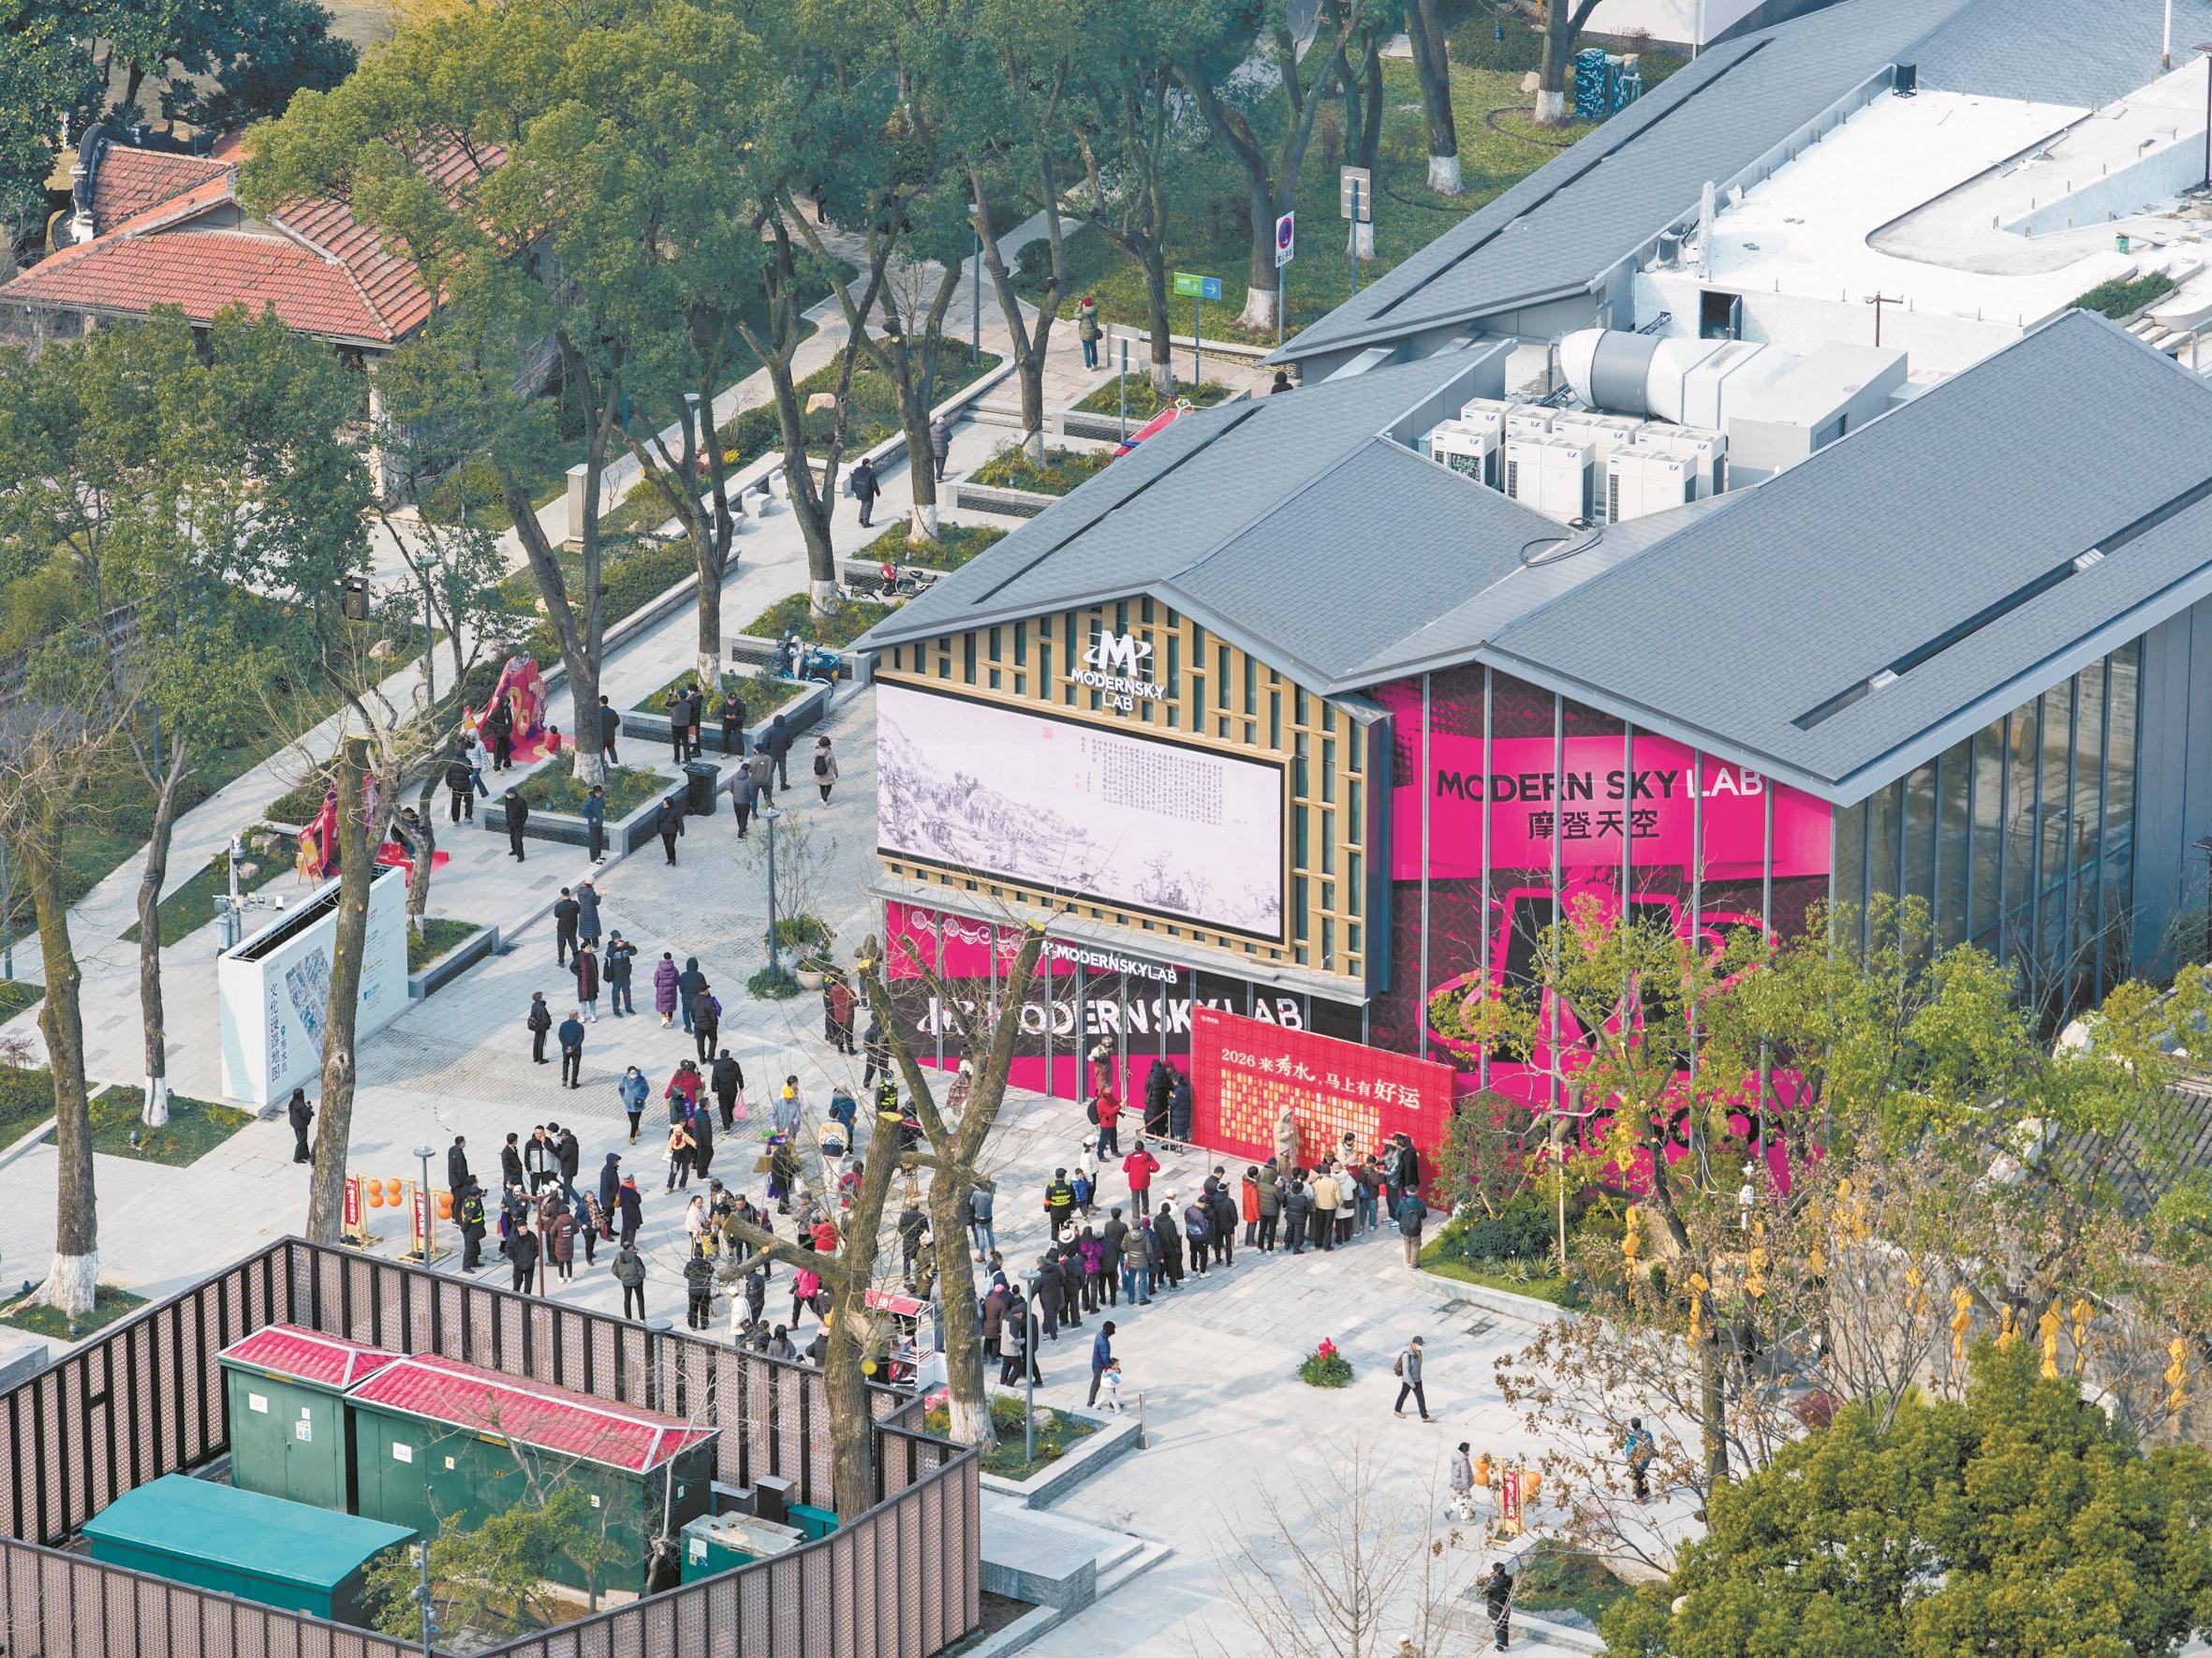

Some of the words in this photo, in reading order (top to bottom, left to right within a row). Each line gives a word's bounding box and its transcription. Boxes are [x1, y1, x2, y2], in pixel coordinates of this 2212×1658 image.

[1070, 668, 1166, 700] MODERNSKY
[1103, 691, 1133, 711] LAB
[1437, 770, 1594, 803] MODERN
[1607, 769, 1679, 801] SKY
[1686, 767, 1763, 798] LAB
[1528, 809, 1660, 840] 摩登天空
[1221, 1048, 1256, 1068] 2026
